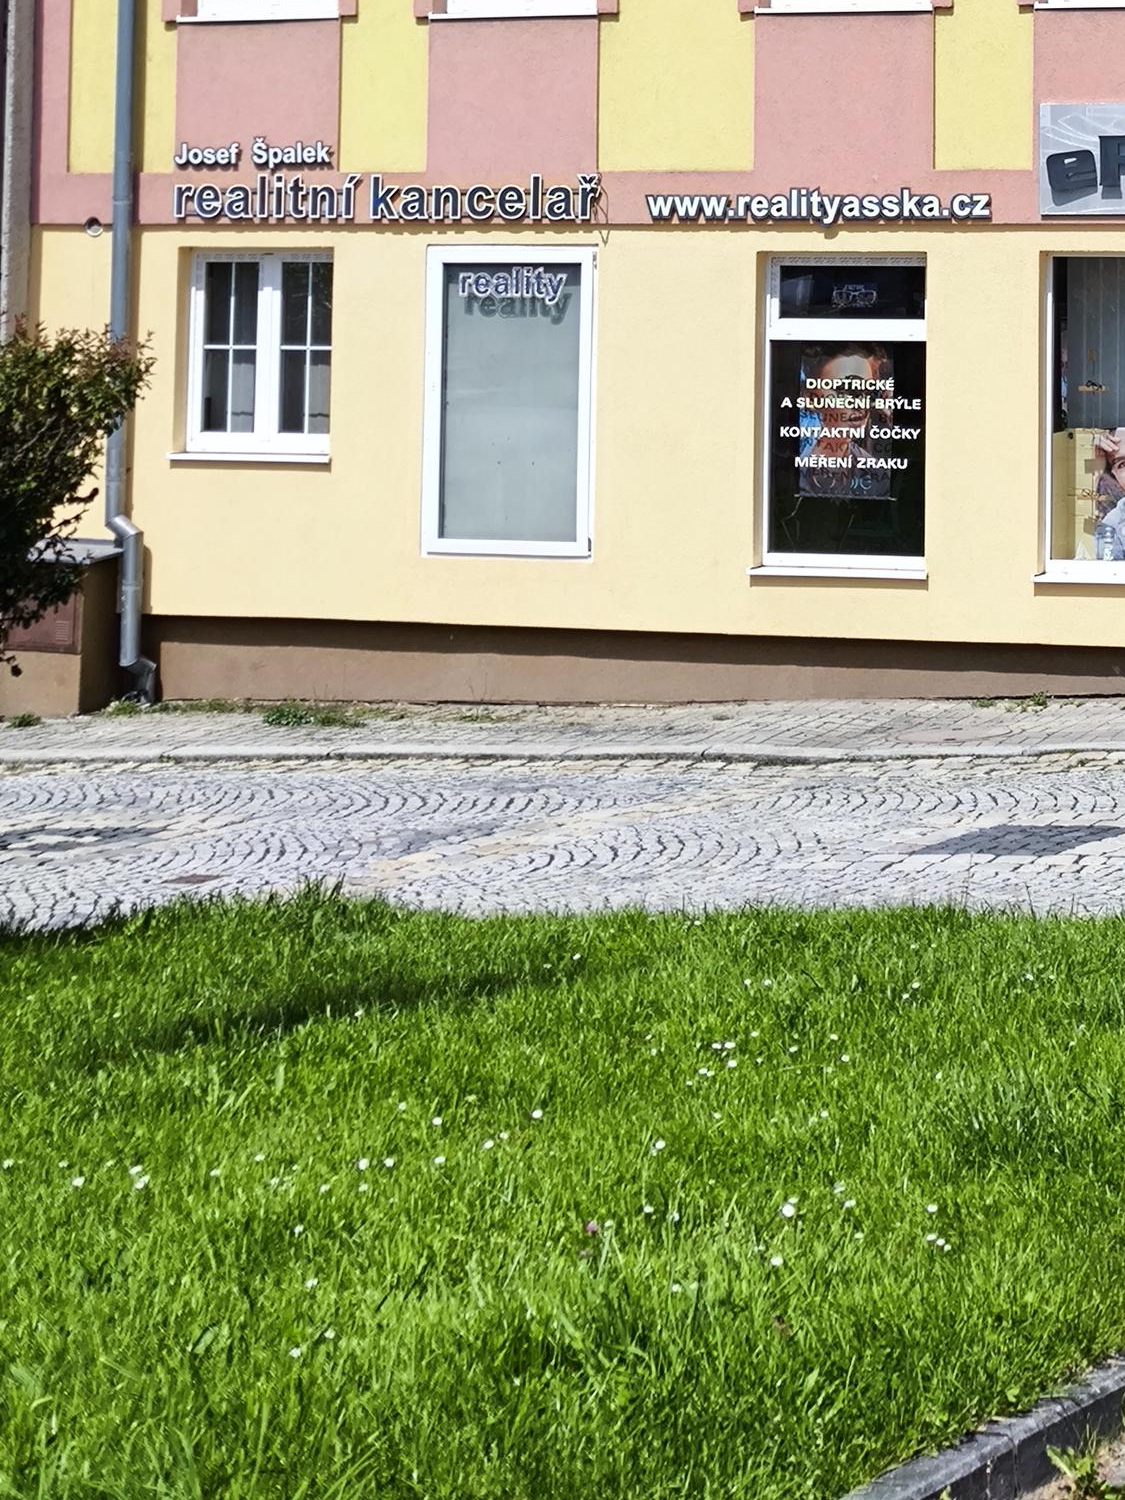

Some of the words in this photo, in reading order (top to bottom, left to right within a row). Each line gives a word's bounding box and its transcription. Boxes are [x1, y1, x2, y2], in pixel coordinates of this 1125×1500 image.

[174, 141, 240, 165] Josef
[252, 136, 331, 169] Špalek
[173, 173, 361, 218] realitní
[369, 173, 601, 219] kancelař
[646, 187, 992, 227] www.realityasska.cz
[459, 266, 568, 305] reality
[805, 377, 895, 391] DIOPTRICKÉ
[780, 397, 793, 408] A
[796, 395, 871, 409] SLUNEČNÍ
[875, 396, 922, 410] BRÝLE
[779, 425, 865, 439] KONTAKTNÍ
[869, 425, 920, 440] ČOČKY
[794, 454, 852, 469] MĚŘENÍ
[856, 457, 908, 470] ZRAKU
